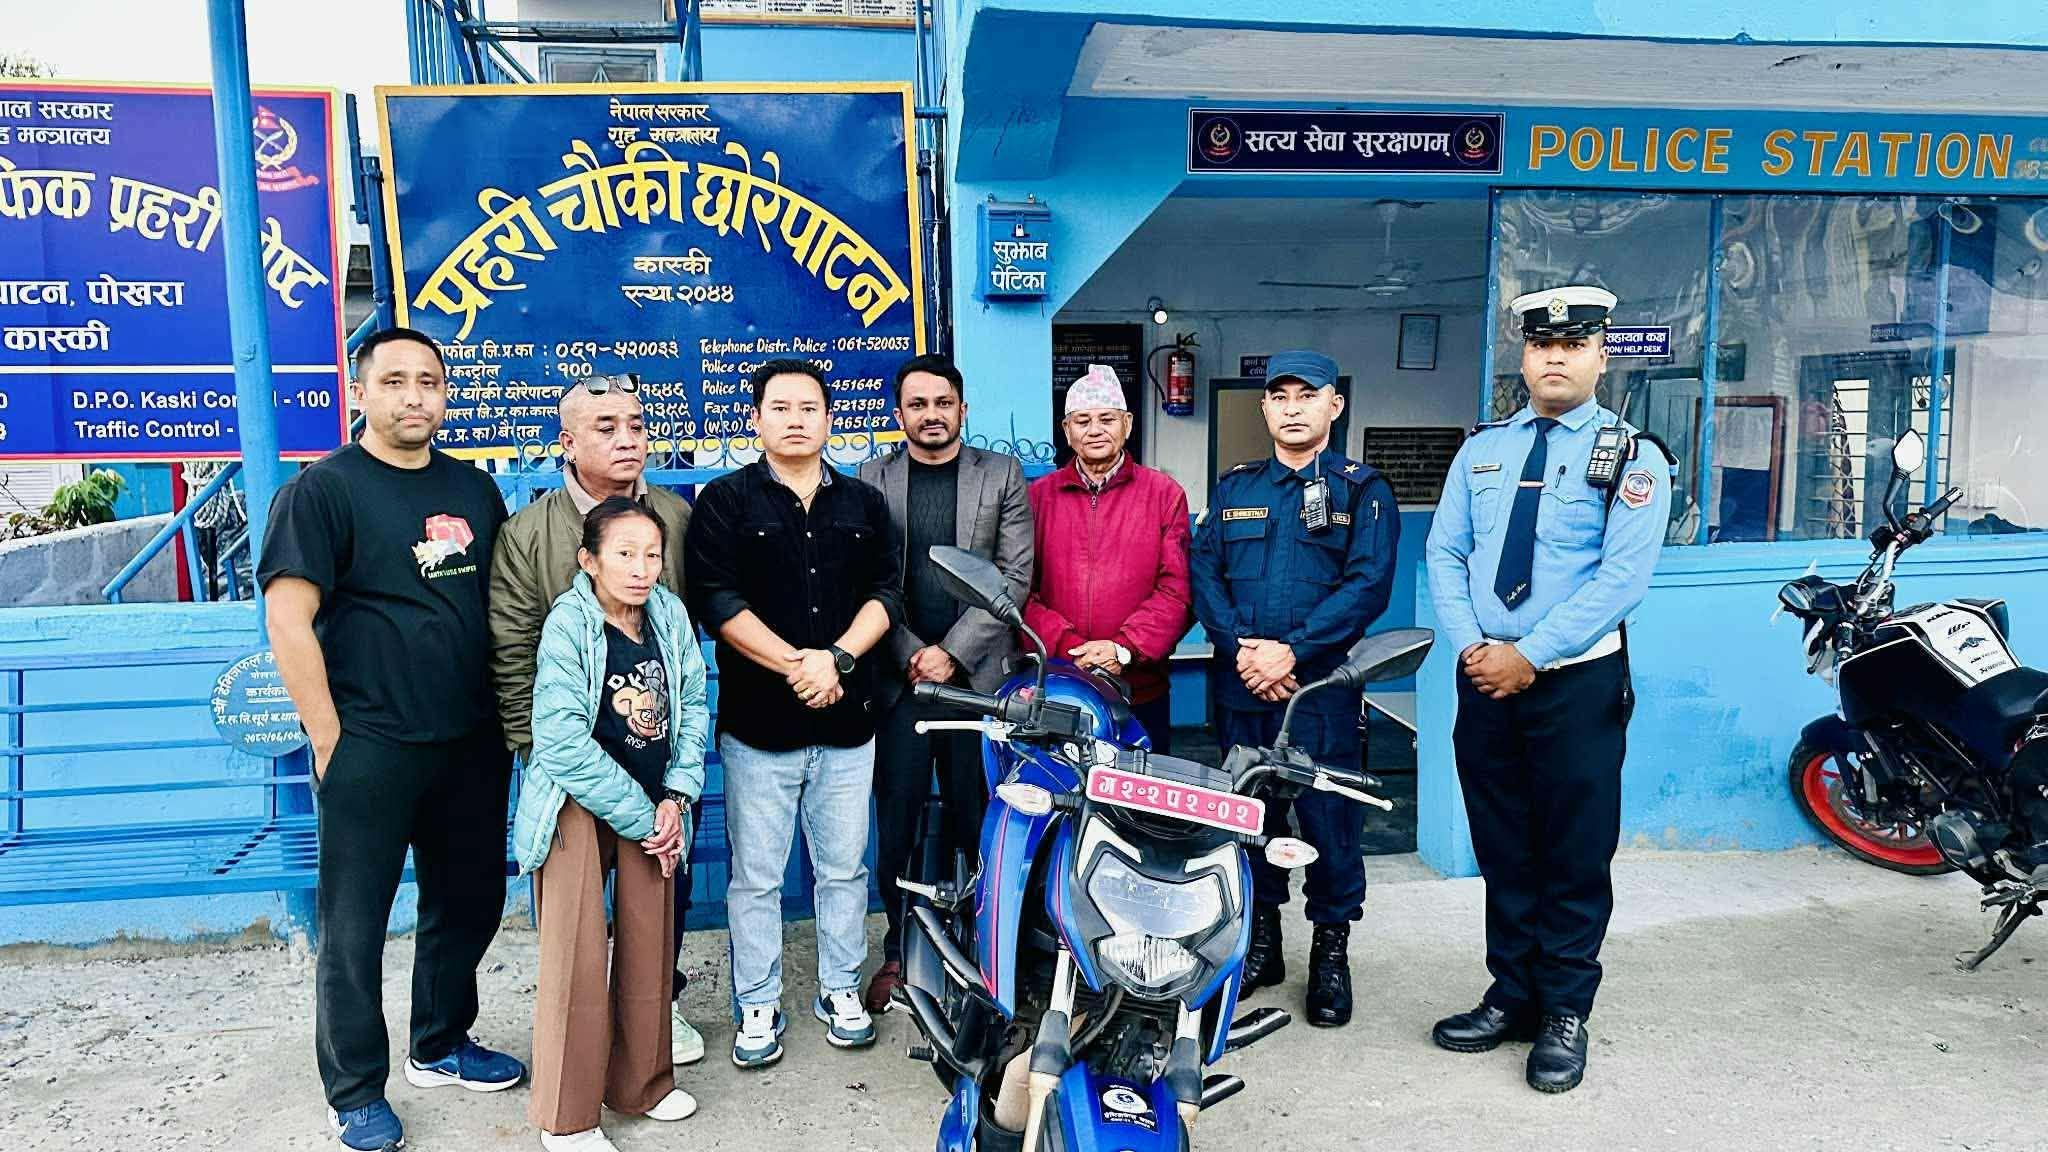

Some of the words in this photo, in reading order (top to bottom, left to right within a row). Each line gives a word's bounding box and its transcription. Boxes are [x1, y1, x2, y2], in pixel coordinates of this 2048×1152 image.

[38, 101, 113, 121] सरकार
[655, 104, 711, 122] सरकार
[16, 126, 112, 146] मन्त्रालय
[1245, 130, 1297, 153] सत्य
[1303, 125, 1346, 153] सेवा
[1352, 131, 1451, 158] सुरक्षणम्
[1529, 124, 1733, 174] POLICE
[1762, 129, 2013, 179] STATION
[108, 174, 221, 252] प्रहरी
[413, 187, 560, 340] प्रहरी
[538, 140, 689, 234] चौकी
[693, 143, 911, 328] छोरेपाटन
[632, 247, 713, 276] कास्की
[990, 264, 1047, 291] पेटिका
[86, 273, 185, 307] पोखरा
[3, 319, 111, 353] कास्की
[699, 339, 753, 356] Telephone
[757, 337, 790, 353] Distr.
[793, 336, 827, 352] Police
[1623, 345, 1643, 353] HELP
[1643, 345, 1662, 353] DESK
[557, 362, 593, 377] १००
[701, 359, 735, 375] Police
[702, 379, 736, 396] Police
[73, 391, 134, 409] D.P.O.
[140, 391, 197, 409] Kaski
[296, 390, 331, 408] 100
[704, 401, 730, 415] Fax
[75, 420, 140, 438] Traffic
[145, 420, 220, 438] Control
